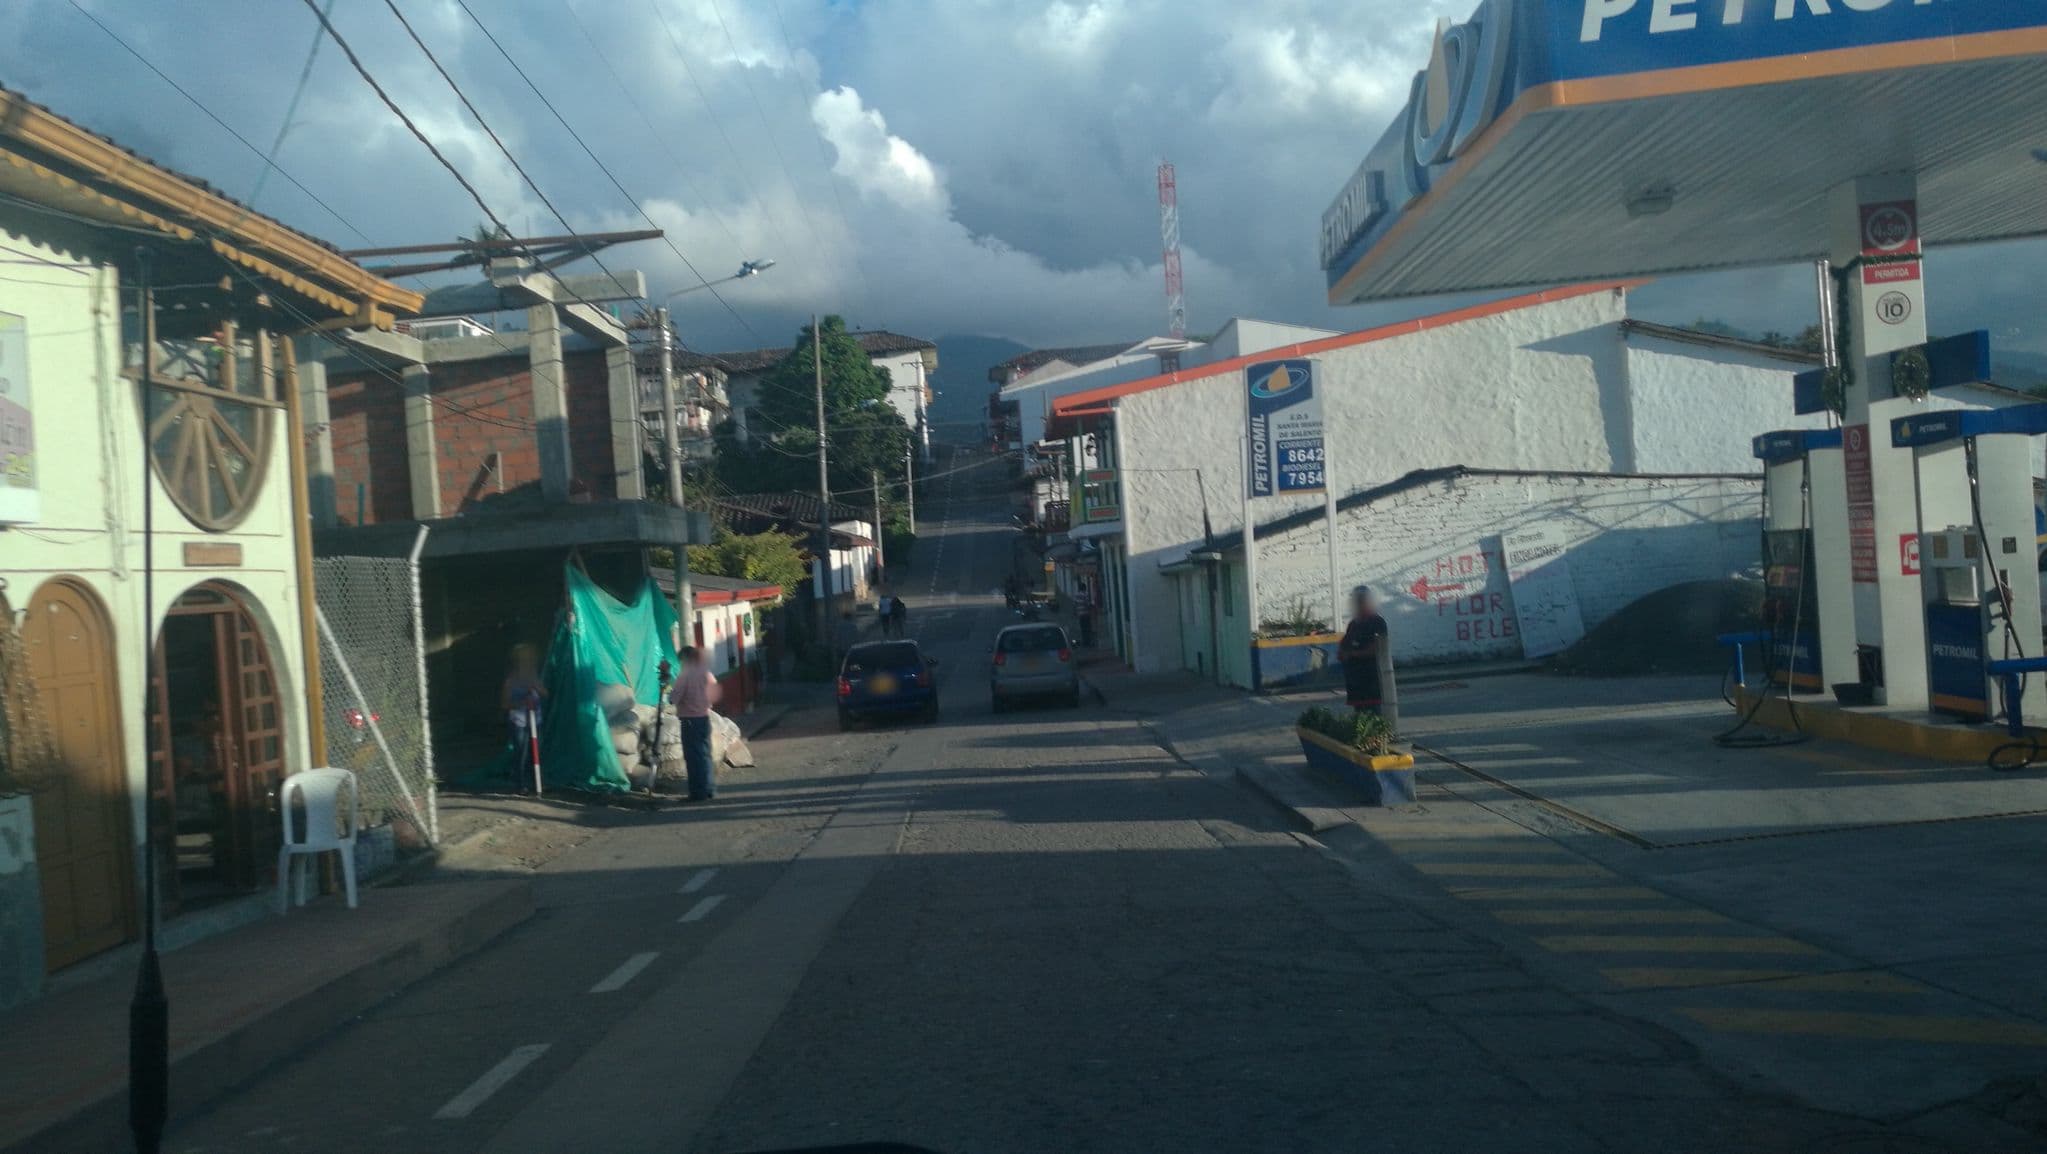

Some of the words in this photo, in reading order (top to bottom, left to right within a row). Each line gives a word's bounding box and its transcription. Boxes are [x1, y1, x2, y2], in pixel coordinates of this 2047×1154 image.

[1320, 173, 1380, 264] ETROMIL
[1874, 268, 1909, 278] PERMITIDA
[1885, 303, 1904, 317] 10
[1279, 440, 1321, 449] CORRIENTE
[1252, 414, 1269, 492] PETROMIL
[1288, 448, 1324, 462] 8642
[1288, 471, 1323, 485] 7954
[1436, 551, 1506, 577] HOT
[1437, 592, 1504, 616] FLOR
[1456, 617, 1513, 641] BELE
[1933, 644, 1978, 660] PETROMIL
